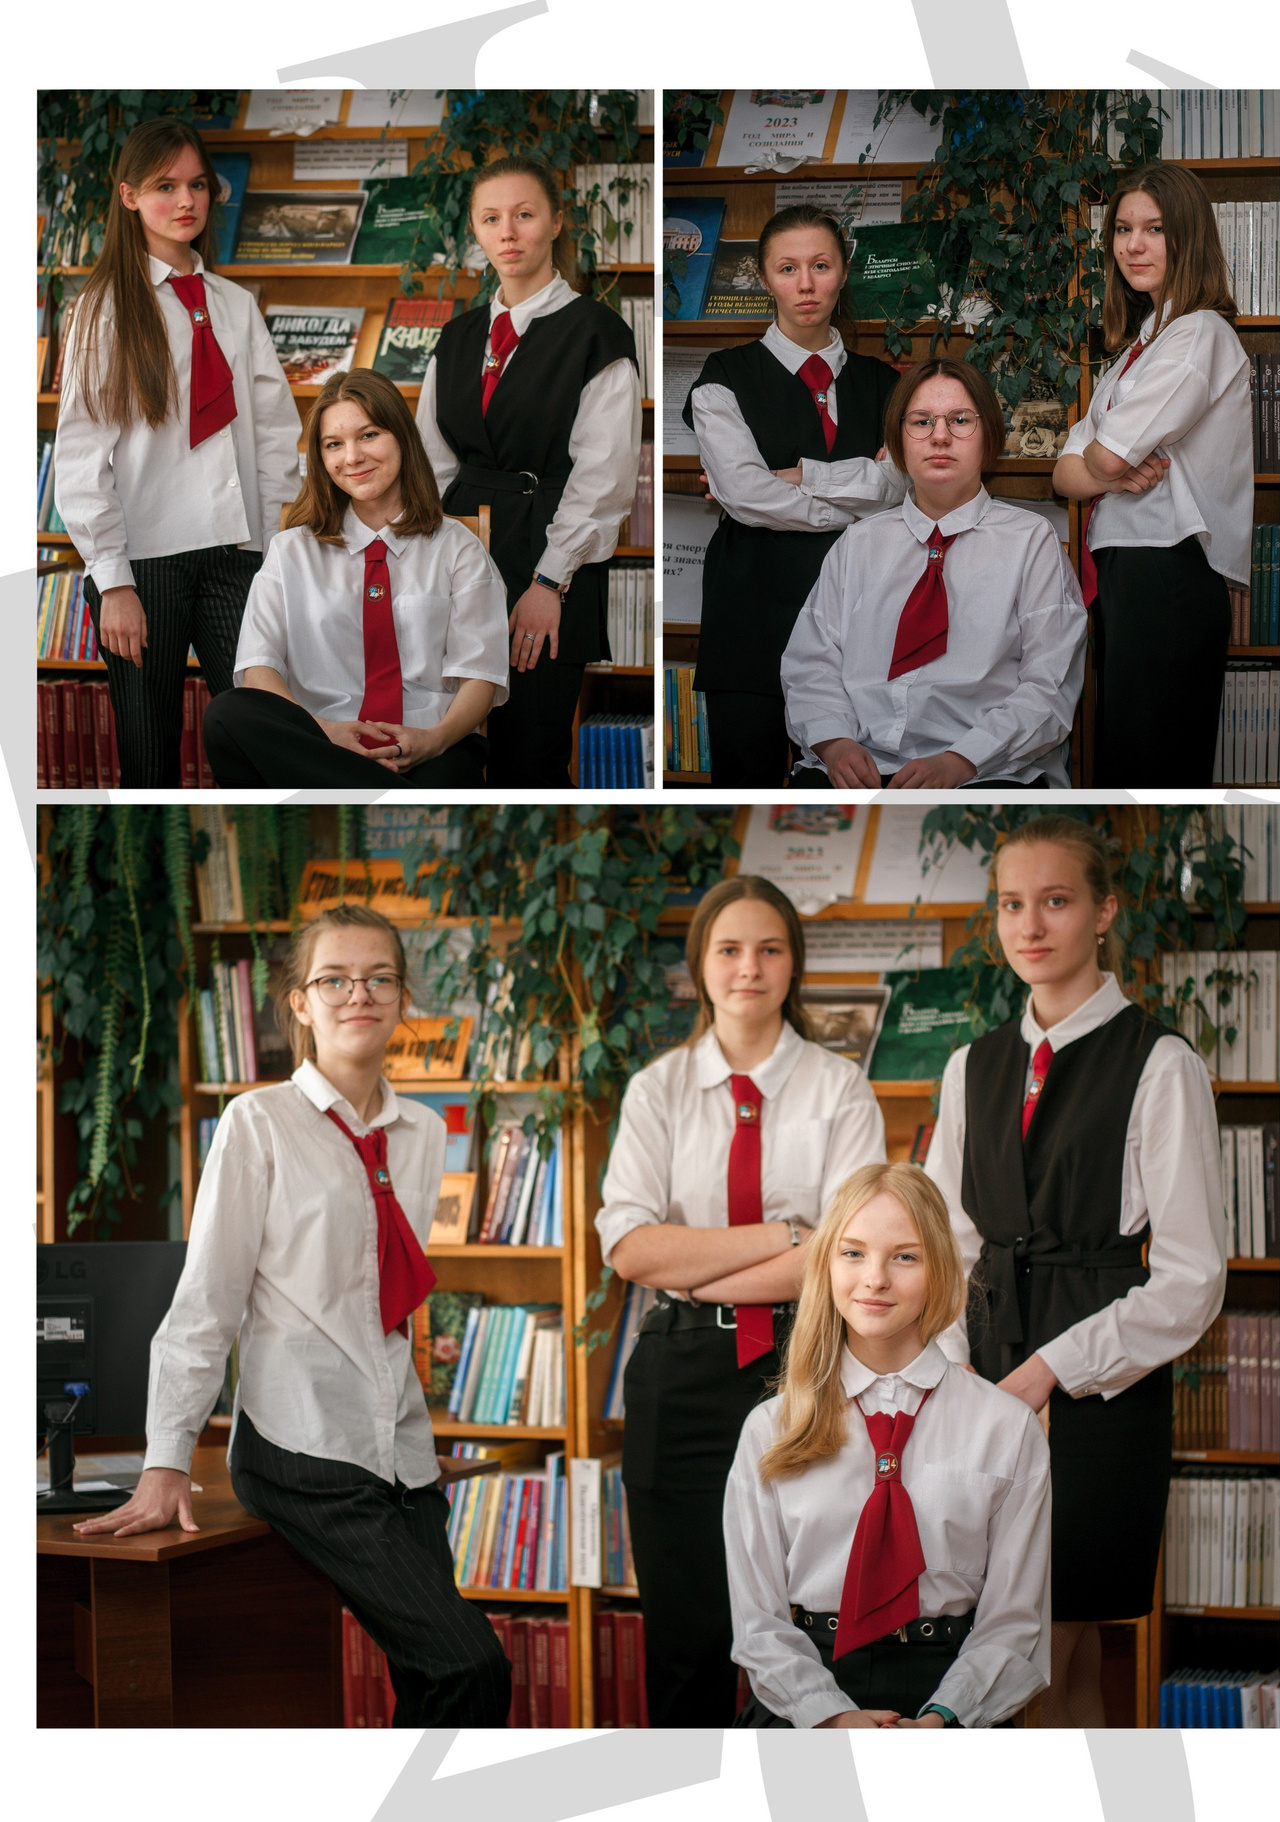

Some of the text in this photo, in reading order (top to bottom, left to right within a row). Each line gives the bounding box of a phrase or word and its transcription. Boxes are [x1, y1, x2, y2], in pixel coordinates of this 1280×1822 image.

[764, 117, 799, 128] 2023
[742, 132, 761, 140] ГОД
[748, 140, 804, 148] СОЗИДАНИЯ
[272, 316, 351, 334] НИКОГДА
[287, 334, 347, 345] ЗАБУДЕМ
[56, 1260, 87, 1279] LG
[888, 1458, 896, 1470] 14
